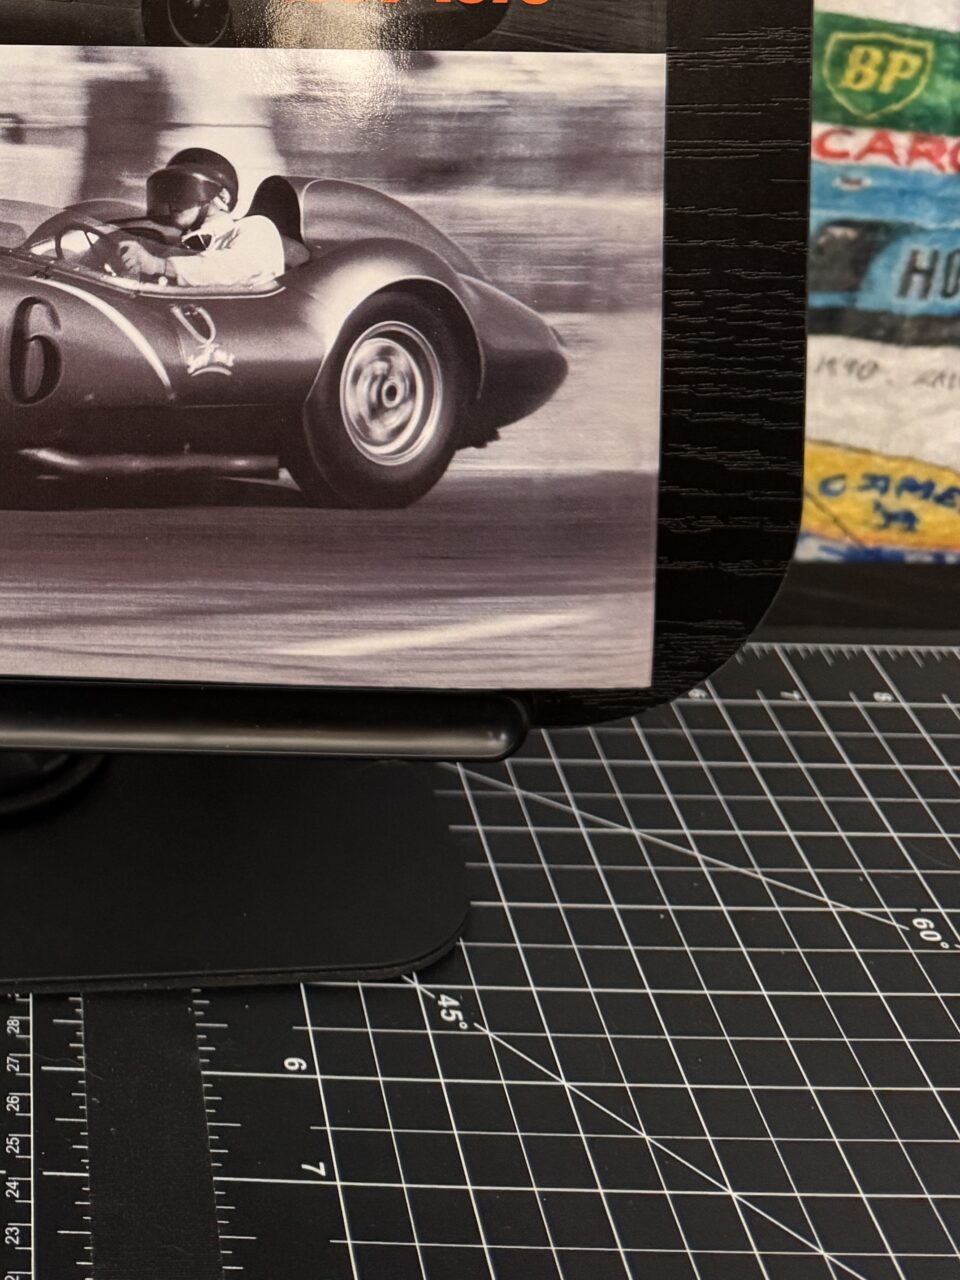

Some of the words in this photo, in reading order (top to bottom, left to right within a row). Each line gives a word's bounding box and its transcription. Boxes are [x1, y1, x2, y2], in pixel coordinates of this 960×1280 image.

[841, 45, 923, 95] BP
[437, 993, 469, 1030] 45°
[6, 1018, 21, 1035] 28
[6, 1056, 20, 1072] 27
[283, 1057, 308, 1072] 6
[5, 1095, 20, 1112] 26
[5, 1136, 20, 1154] 25
[300, 1161, 327, 1177] 7
[5, 1180, 20, 1199] 24
[4, 1226, 20, 1245] 23
